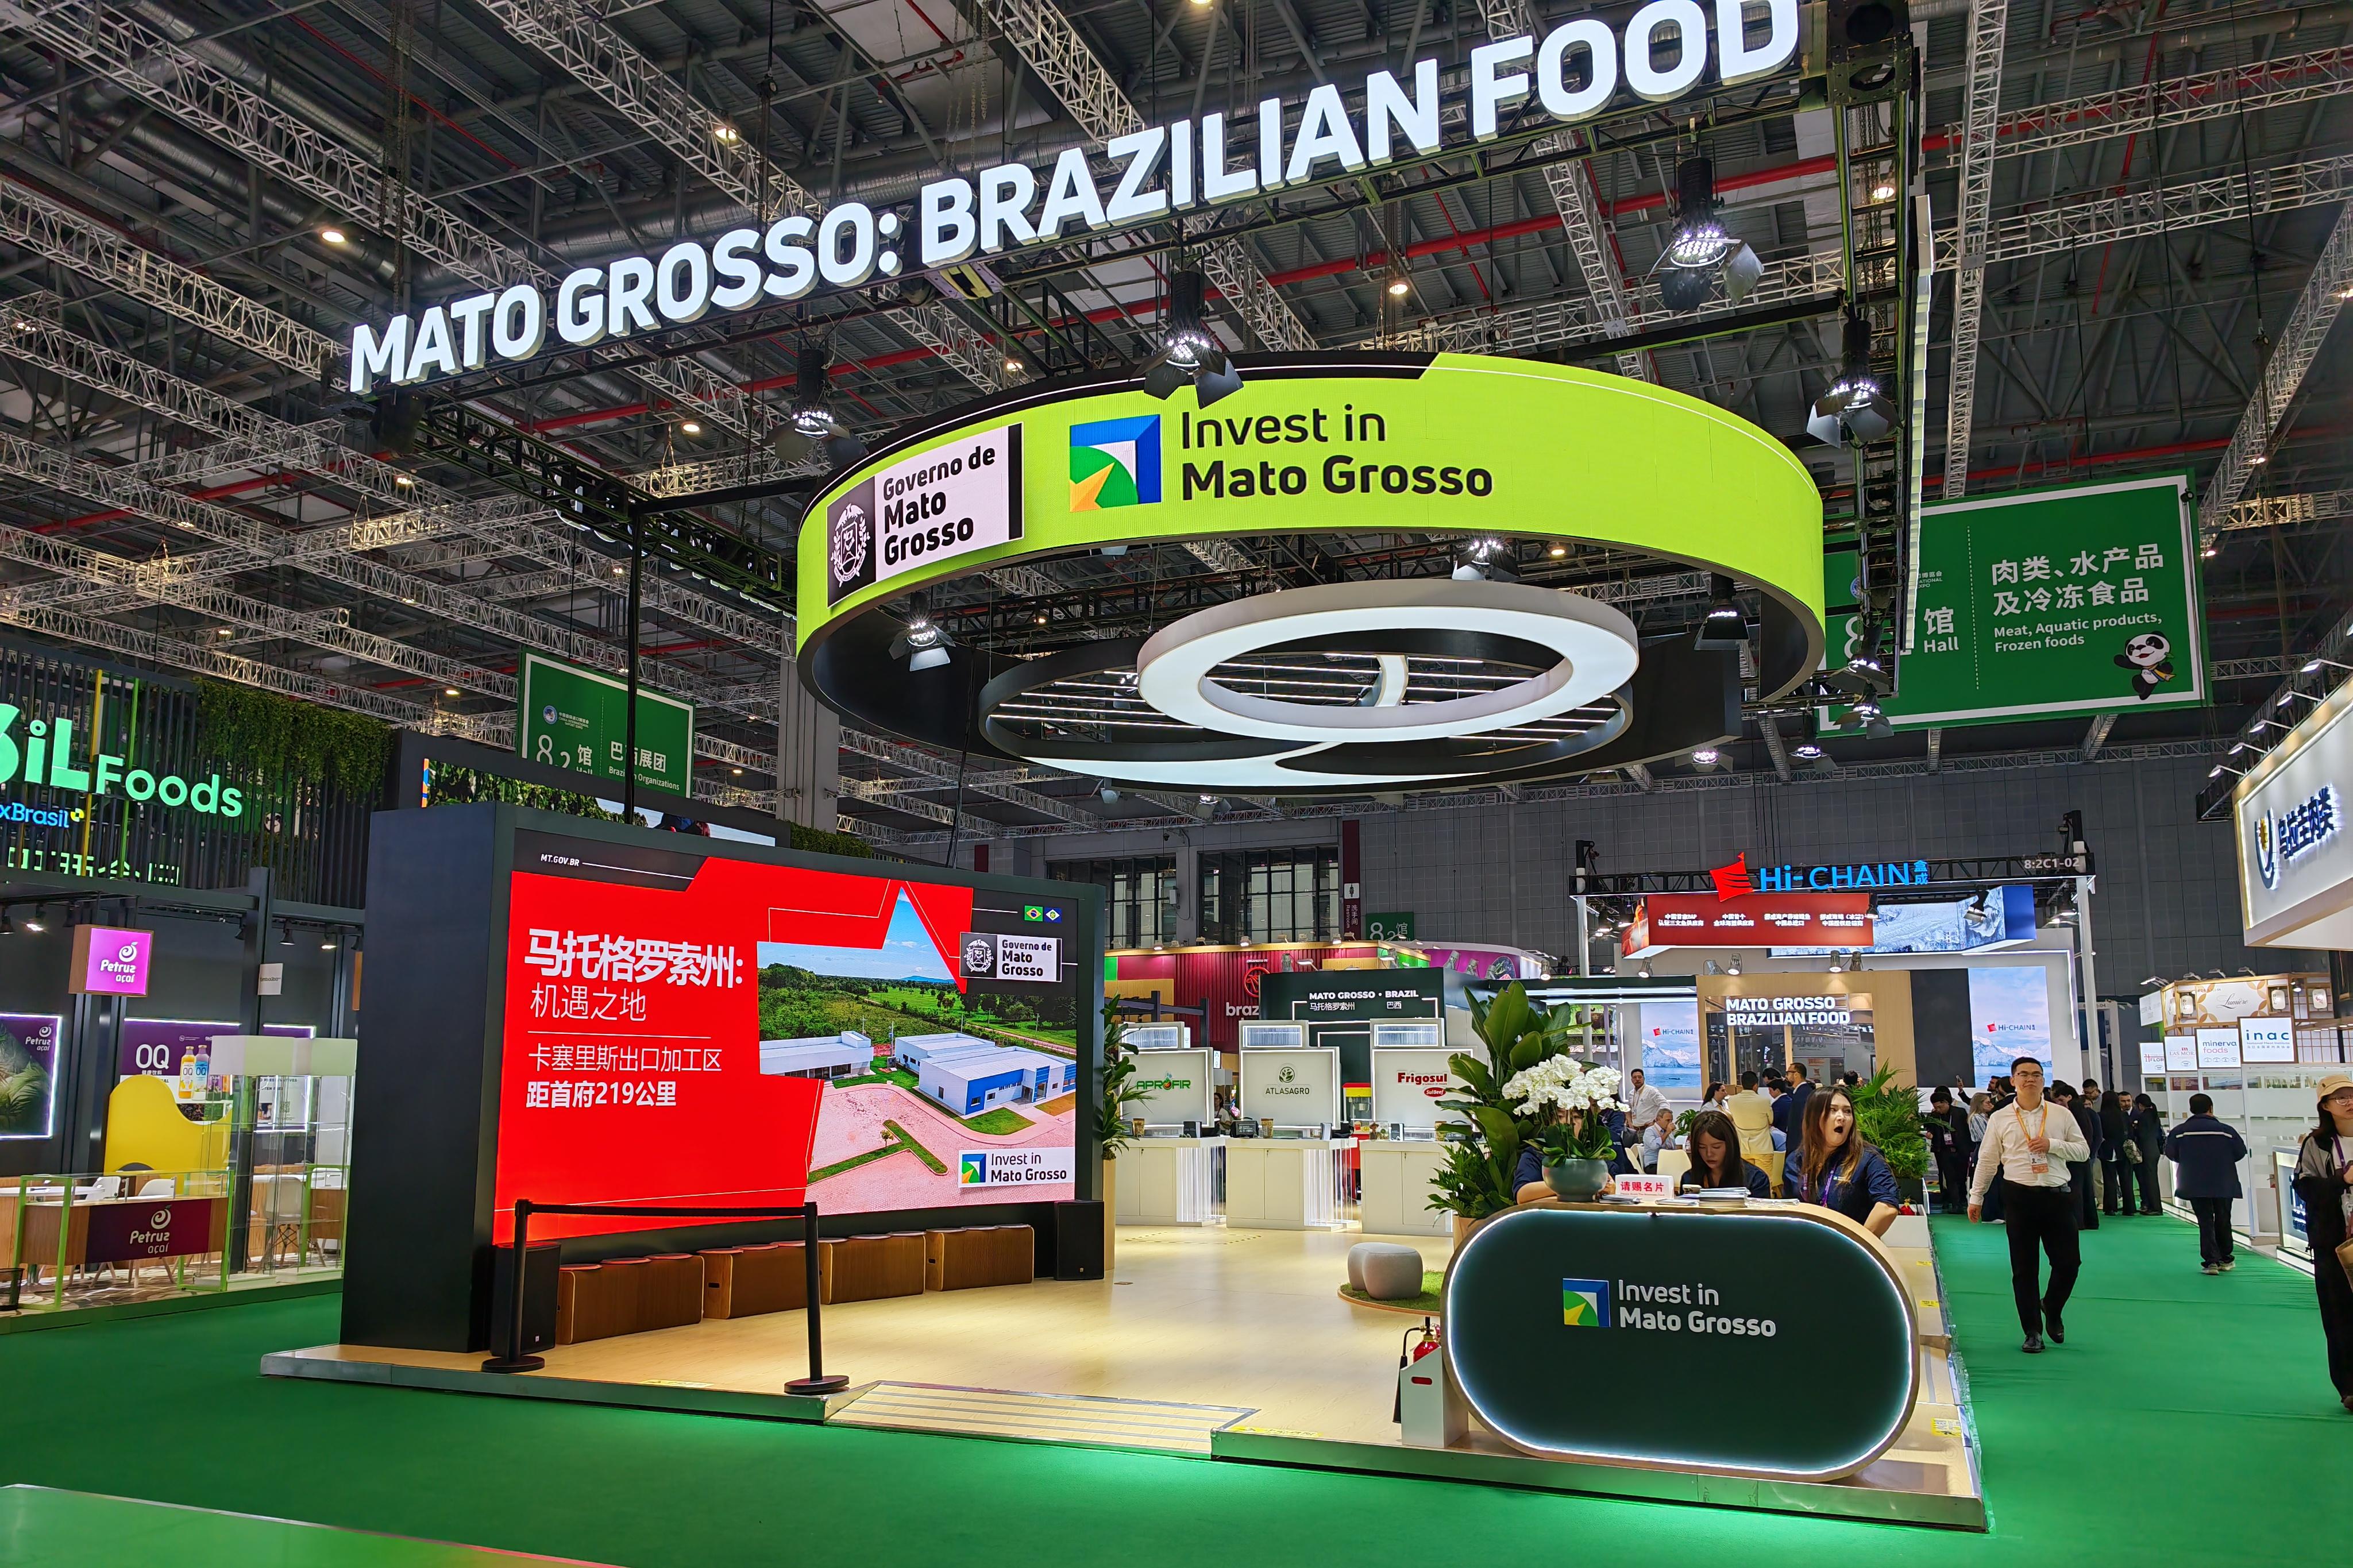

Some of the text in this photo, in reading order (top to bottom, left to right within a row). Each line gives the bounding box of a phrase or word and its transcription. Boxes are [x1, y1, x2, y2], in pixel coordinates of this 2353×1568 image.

[350, 0, 1799, 395] MATO GROSSO: BRAZILIAN FOOD
[1182, 403, 1385, 449] Invest in
[883, 446, 996, 501] Governo de
[1183, 454, 1492, 500] Mato Grosso
[884, 492, 946, 535] Mato
[884, 517, 974, 566] Grosso
[1992, 543, 2163, 585] 肉类、水产品
[1993, 577, 2148, 616] 及冷冻食品
[1924, 607, 1954, 635] 馆
[1995, 612, 2162, 638] Meat, Aquatic products,
[1924, 636, 1959, 653] Hall
[1995, 634, 2085, 652] Frozen foods
[577, 744, 592, 767] 馆
[95, 754, 242, 817] Foods
[638, 773, 680, 791] Organizations
[2278, 785, 2335, 860] 乌拉圭肉类
[541, 853, 580, 867] MT.GOV.BR
[2024, 858, 2080, 869] 8:2C1-02
[1351, 904, 1359, 925] 洗手间
[1002, 939, 1052, 951] Governo de
[524, 928, 743, 988] 马托格罗索州:
[1002, 950, 1032, 963] Mato
[100, 959, 136, 974] Petruz
[1002, 963, 1043, 976] Grosso
[530, 982, 646, 1021] 机遇之地
[1337, 991, 1376, 999] GROSSO
[1385, 990, 1419, 998] BRAZIL
[1310, 1002, 1355, 1011] 马托格罗索州
[1387, 1001, 1402, 1009] 巴西
[1726, 997, 1835, 1011] MATO GROSSO
[1727, 1011, 1850, 1026] BRAZILIAN FOOD
[25, 1036, 51, 1045] Petruz
[2246, 1029, 2289, 1040] inac
[528, 1042, 722, 1072] 卡塞里斯出口加工区
[1398, 1072, 1448, 1085] Frigosul
[526, 1080, 677, 1109] 距首府219公里
[991, 1152, 1042, 1166] Invest in
[991, 1168, 1067, 1183] Mato Grosso
[129, 1230, 170, 1245] Petruz
[148, 1242, 169, 1254] açaí
[1618, 1279, 1719, 1306] Invest in
[1619, 1307, 1776, 1337] Mato Grosso
